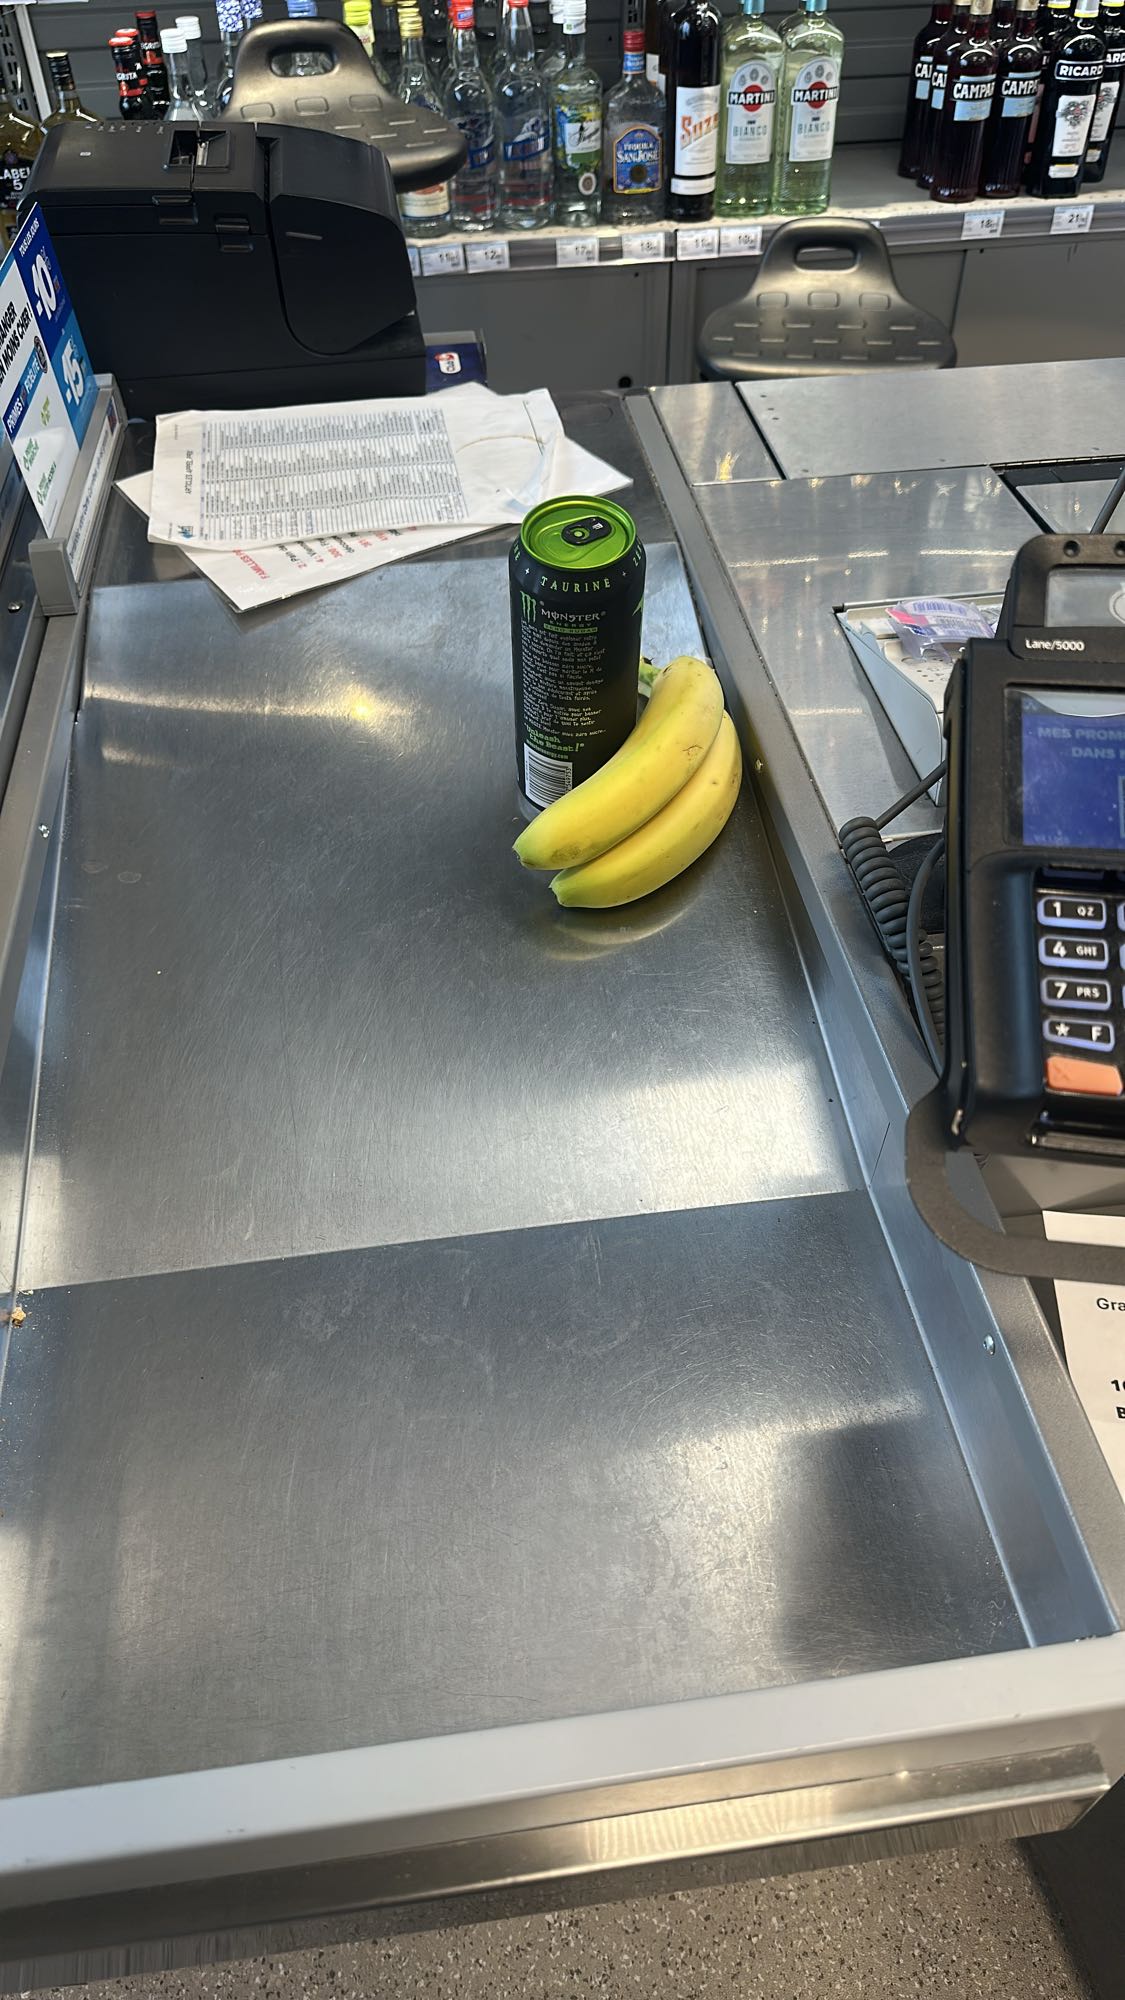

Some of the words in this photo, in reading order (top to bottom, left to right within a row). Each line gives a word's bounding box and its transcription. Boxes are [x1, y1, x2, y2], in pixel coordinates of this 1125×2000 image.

[1060, 65, 1103, 76] RICARD
[733, 125, 767, 136] BIANCO
[798, 122, 829, 134] BIANCO
[13, 179, 23, 190] 5
[541, 576, 611, 592] TAURINE
[1038, 727, 1072, 738] MES
[1072, 747, 1116, 759] DANS
[1077, 906, 1094, 916] QZ
[1053, 942, 1067, 957] 4
[1076, 945, 1098, 957] GHI
[1054, 982, 1067, 999] 7
[1076, 986, 1100, 998] PRS
[1091, 1026, 1102, 1041] F
